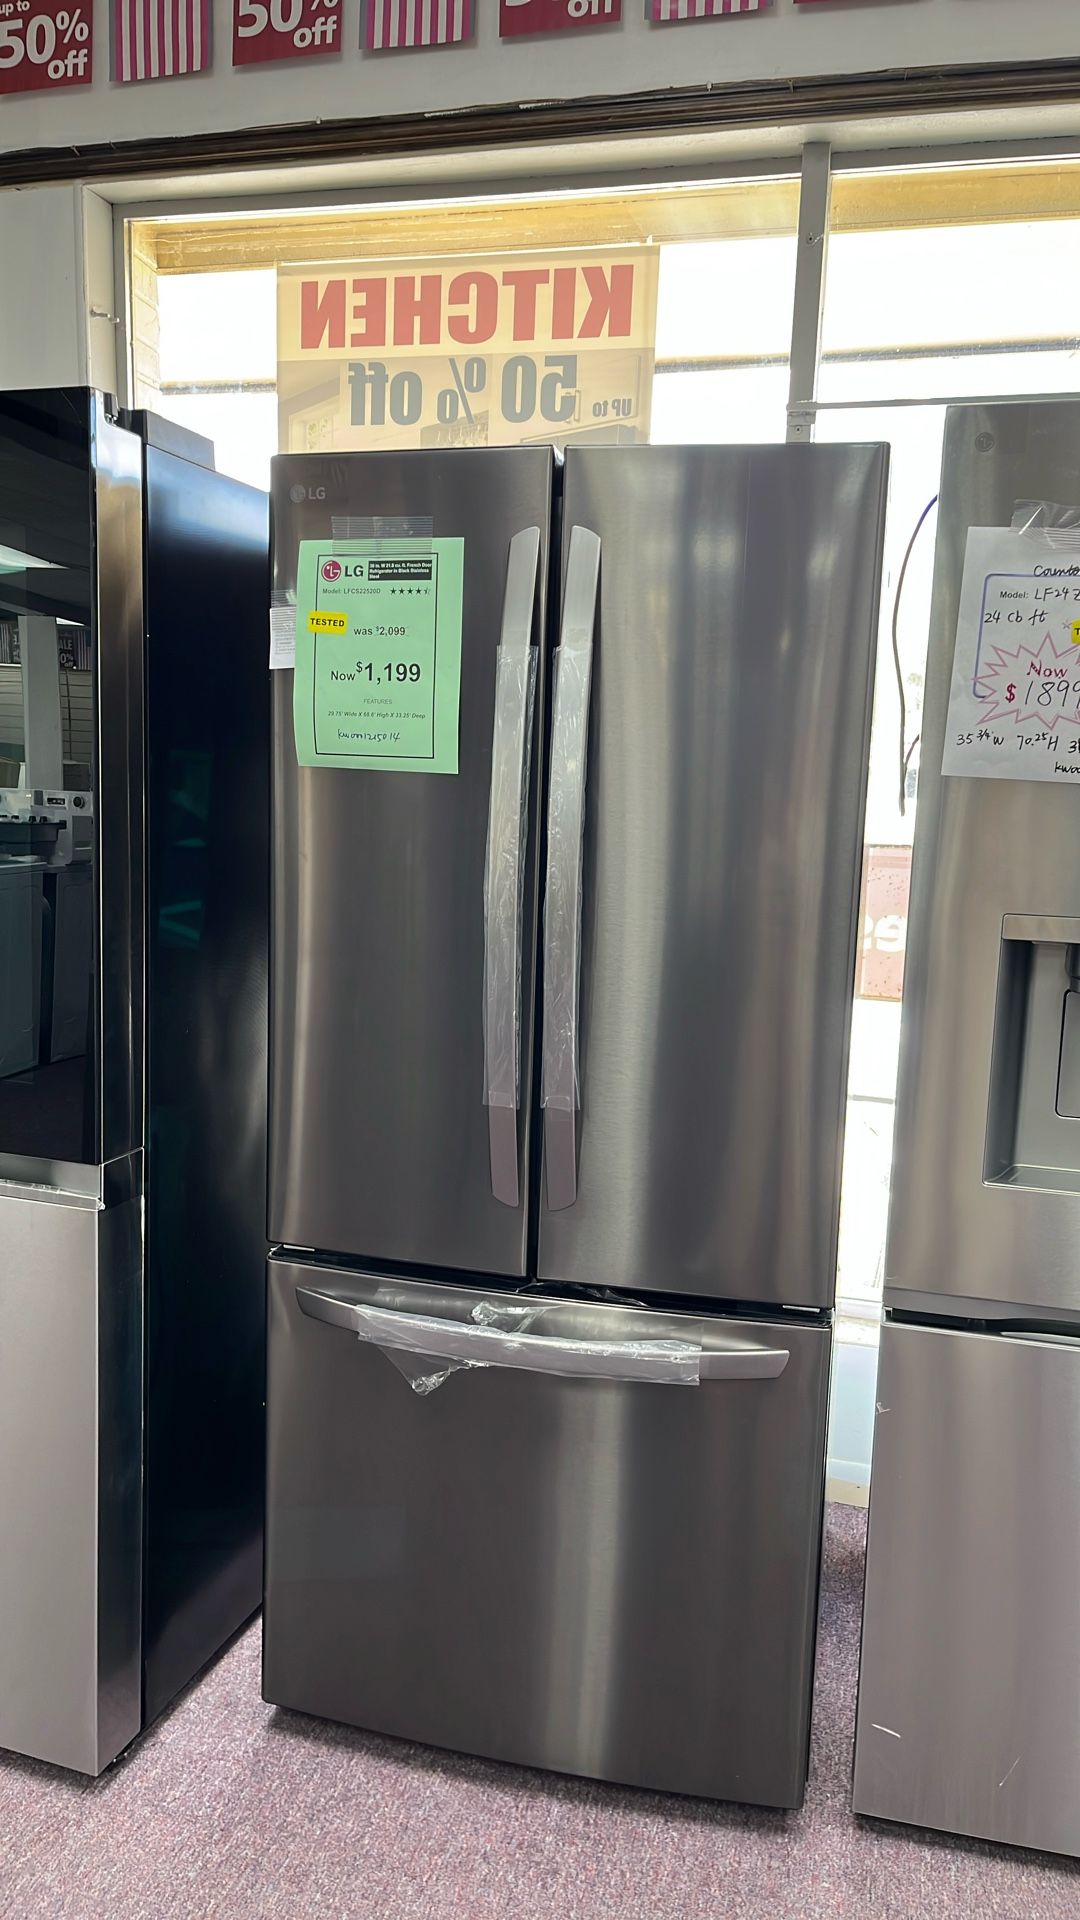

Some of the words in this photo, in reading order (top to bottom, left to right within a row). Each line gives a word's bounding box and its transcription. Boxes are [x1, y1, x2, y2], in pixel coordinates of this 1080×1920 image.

[16, 0, 30, 11] to
[293, 15, 337, 48] off
[0, 9, 89, 69] 50%
[47, 48, 88, 80] off
[308, 487, 326, 500] LG
[344, 565, 364, 577] LG
[1000, 591, 1029, 599] Model:
[310, 617, 345, 627] TESTED
[984, 609, 1001, 624] 24
[1028, 608, 1048, 626] ft
[353, 627, 373, 636] was
[375, 625, 406, 636] $2,099
[330, 670, 356, 682] Now
[355, 661, 421, 685] $1,199
[1026, 660, 1068, 679] Now
[376, 711, 389, 719] High
